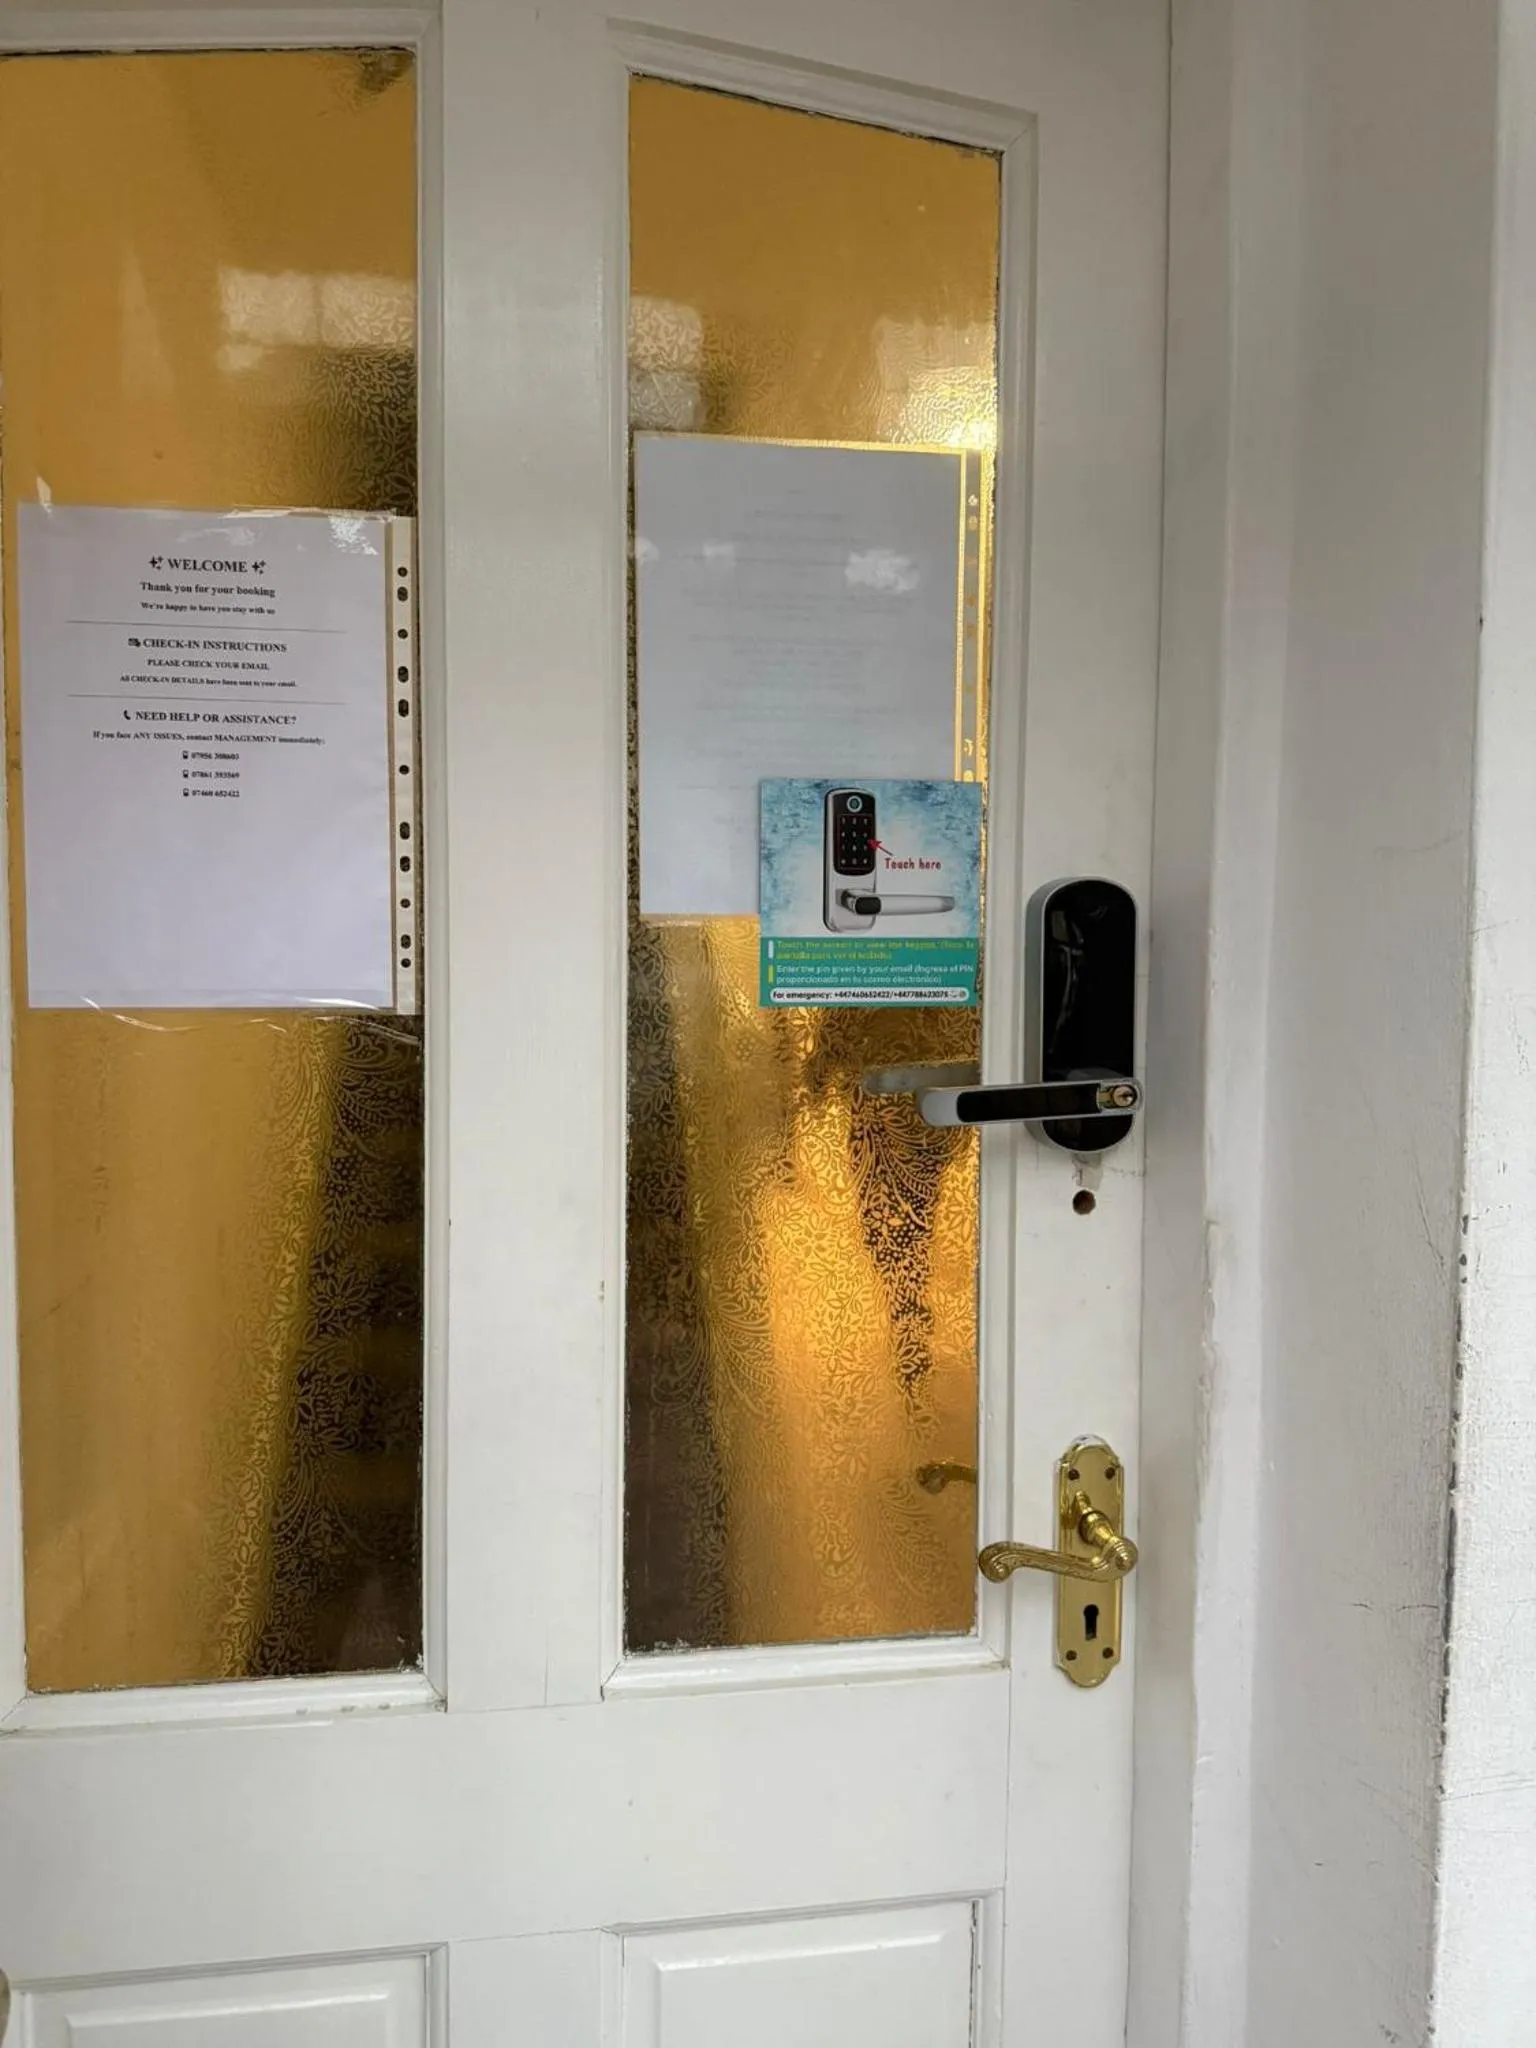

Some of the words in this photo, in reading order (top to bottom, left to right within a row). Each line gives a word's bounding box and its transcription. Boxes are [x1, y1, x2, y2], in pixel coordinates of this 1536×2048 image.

[168, 558, 248, 573] WELCOME
[140, 582, 172, 592] Thank
[175, 584, 192, 594] you
[195, 584, 209, 593] for
[211, 586, 234, 596] your
[237, 586, 276, 598] booking
[166, 603, 188, 612] happy
[218, 606, 231, 614] you
[232, 607, 247, 615] stay
[143, 639, 200, 650] CHECK-IN
[203, 641, 288, 652] INSTRUCTIONS
[147, 659, 180, 668] PLEASE
[182, 660, 213, 669] CHECK
[215, 661, 240, 670] YOUR
[131, 676, 170, 684] CHECK-IN
[172, 677, 205, 685] DETAILS
[136, 711, 167, 721] NEED
[170, 712, 200, 723] HELP
[203, 714, 220, 723] OR
[223, 714, 297, 725] ASSISTANCE?
[100, 733, 115, 741] you
[117, 732, 131, 740] face
[133, 732, 151, 740] ANY
[187, 734, 213, 742] contact
[215, 735, 276, 744] MANAGEMENT
[885, 858, 915, 870] Touch
[919, 858, 942, 870] here
[817, 966, 830, 975] pin
[832, 966, 855, 975] given
[857, 966, 868, 975] by
[870, 967, 889, 975] your
[890, 965, 913, 973] email
[959, 965, 974, 973] PIN
[787, 993, 833, 1001] emergency:
